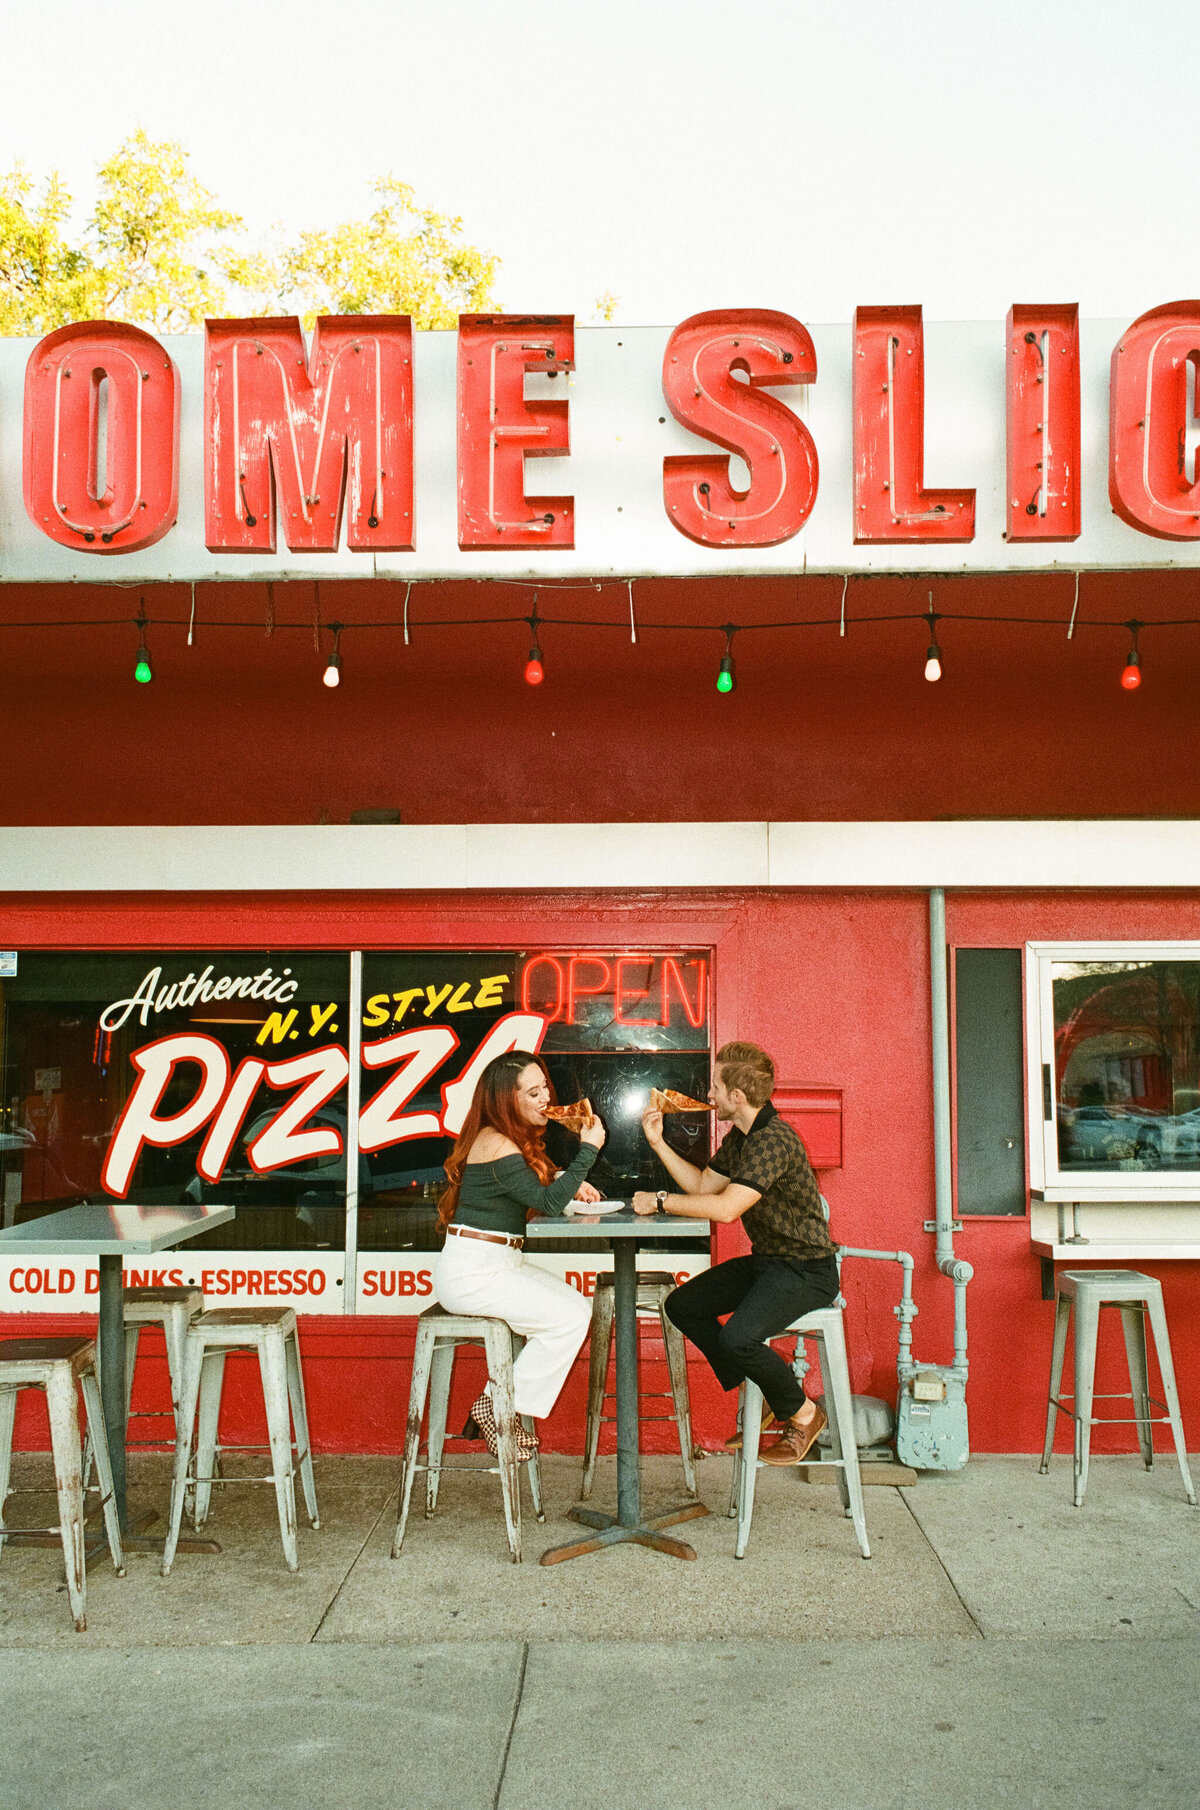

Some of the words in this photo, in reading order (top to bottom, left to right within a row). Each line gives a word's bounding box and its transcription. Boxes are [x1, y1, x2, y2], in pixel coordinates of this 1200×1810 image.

[100, 965, 298, 1032] Authentic
[256, 1002, 338, 1046] N.Y.
[363, 974, 510, 1027] STYLE
[522, 955, 706, 1028] OPEN
[101, 1010, 550, 1199] PIZZA
[9, 1267, 76, 1294] COLD
[84, 1268, 184, 1294] DINKS
[201, 1269, 326, 1296] ESPRESSO
[362, 1269, 433, 1297] SUBS
